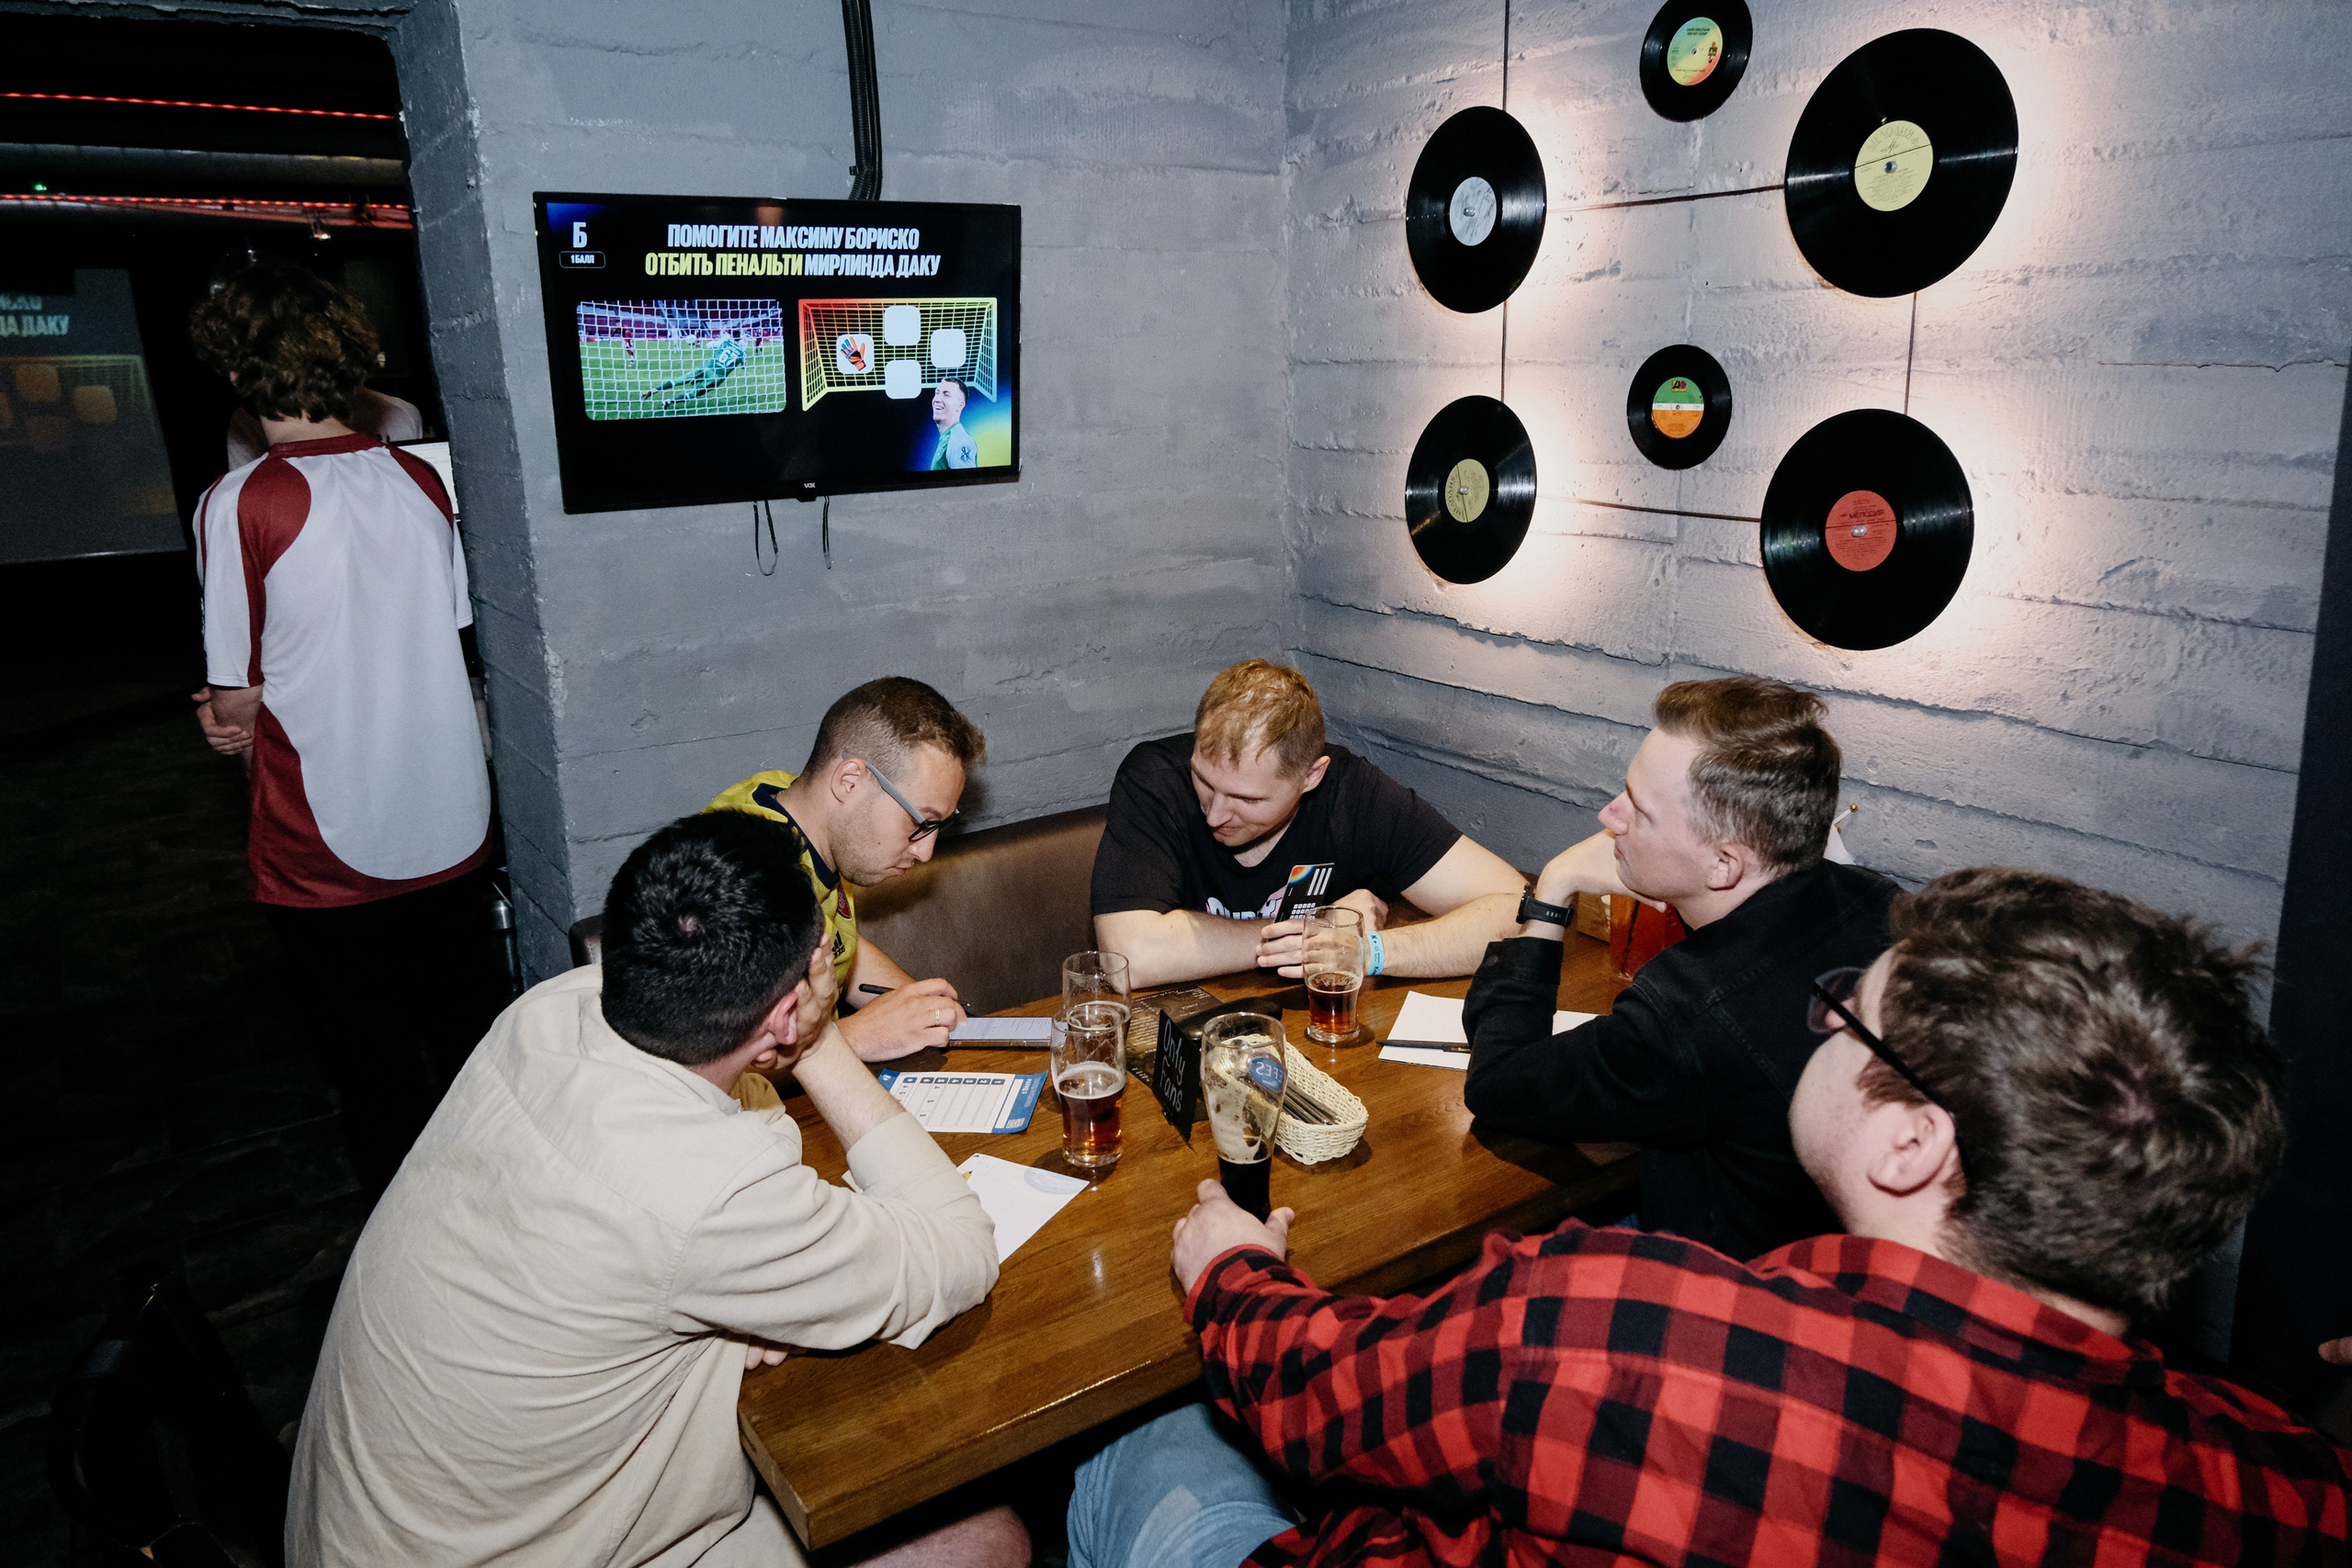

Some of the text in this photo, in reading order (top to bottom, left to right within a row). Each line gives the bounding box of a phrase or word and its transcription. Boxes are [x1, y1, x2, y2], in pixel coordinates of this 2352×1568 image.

[572, 221, 588, 248] Б
[667, 224, 920, 250] ПОМОГИТЕ МАКСИМУ БОРИСКО
[570, 254, 595, 265] 1 БАЛЛ
[645, 252, 942, 278] ОТБИТЬ ПЕНАЛЬТИ МИРЛИНДА ДАКУ
[21, 315, 70, 337] ДАКУ
[1163, 1019, 1186, 1086] Only
[1159, 1055, 1183, 1113] Fans
